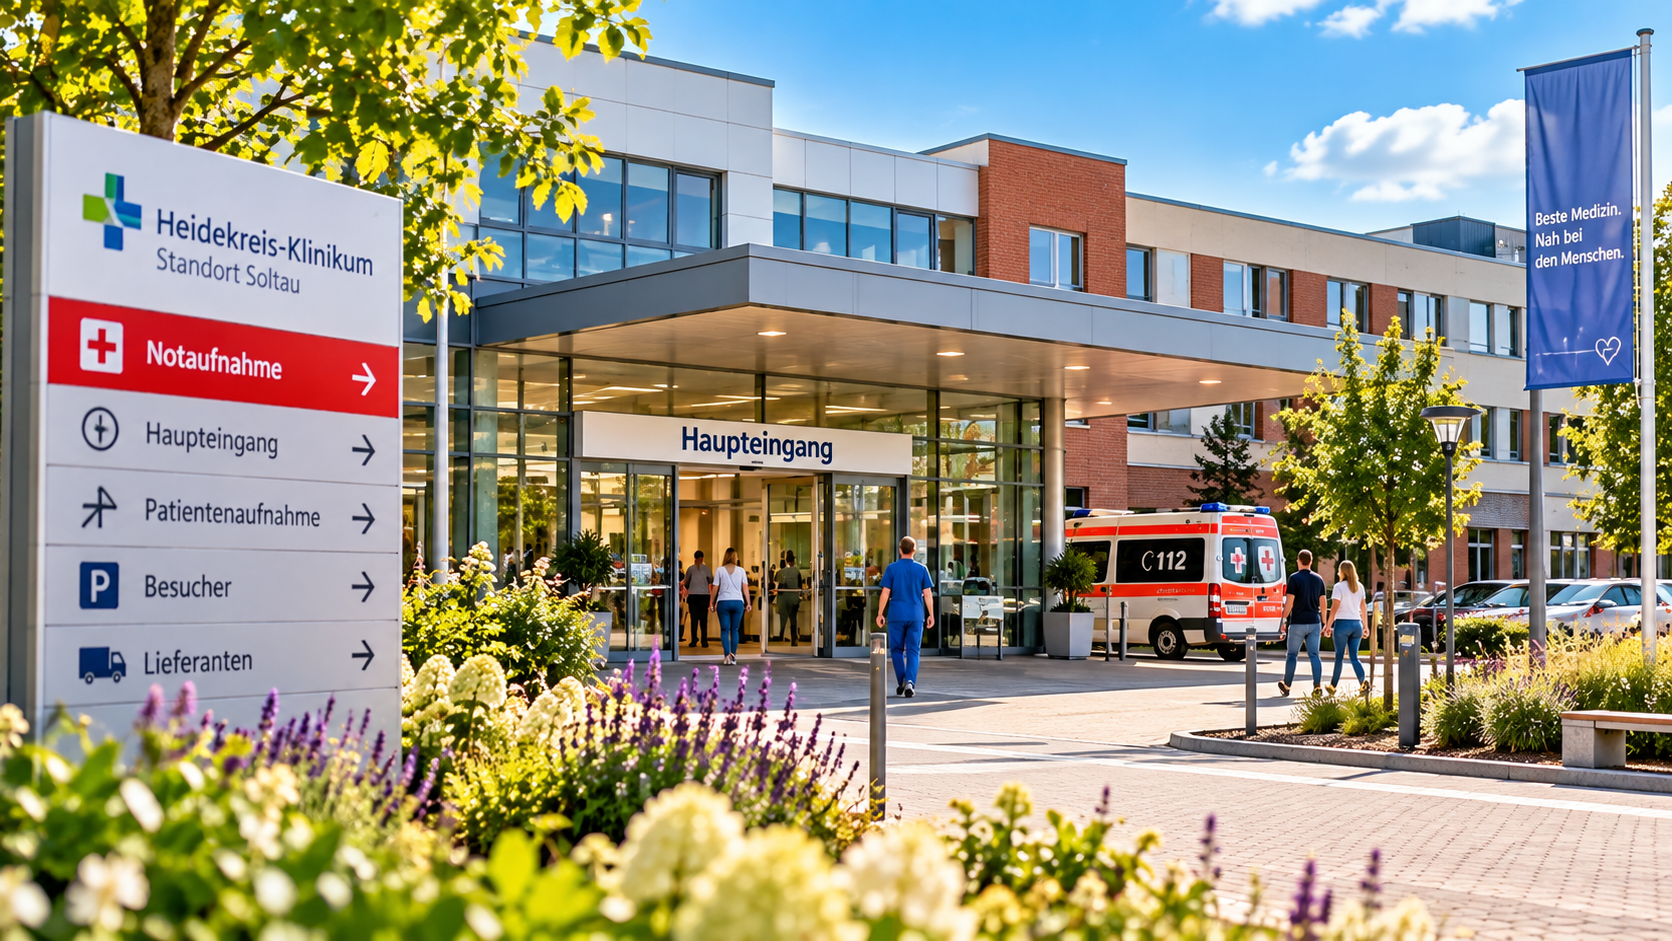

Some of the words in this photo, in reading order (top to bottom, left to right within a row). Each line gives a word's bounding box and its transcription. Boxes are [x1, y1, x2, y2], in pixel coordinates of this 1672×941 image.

[1535, 210, 1567, 226] Beste
[1571, 203, 1621, 220] Medizin.
[156, 208, 374, 277] Heidekreis-Klinikum
[1535, 231, 1560, 248] Nah
[1563, 227, 1583, 244] bei
[156, 247, 241, 284] Standort
[246, 264, 301, 294] Soltau
[1535, 253, 1558, 269] den
[1561, 247, 1624, 264] Menschen.
[146, 339, 283, 380] Notaufnahme
[146, 421, 279, 460] Haupteingang
[681, 425, 833, 466] Haupteingang
[145, 497, 321, 528] Patientenaufnahme
[90, 569, 111, 603] P
[144, 574, 232, 599] Besucher
[144, 649, 253, 676] Lieferanten
